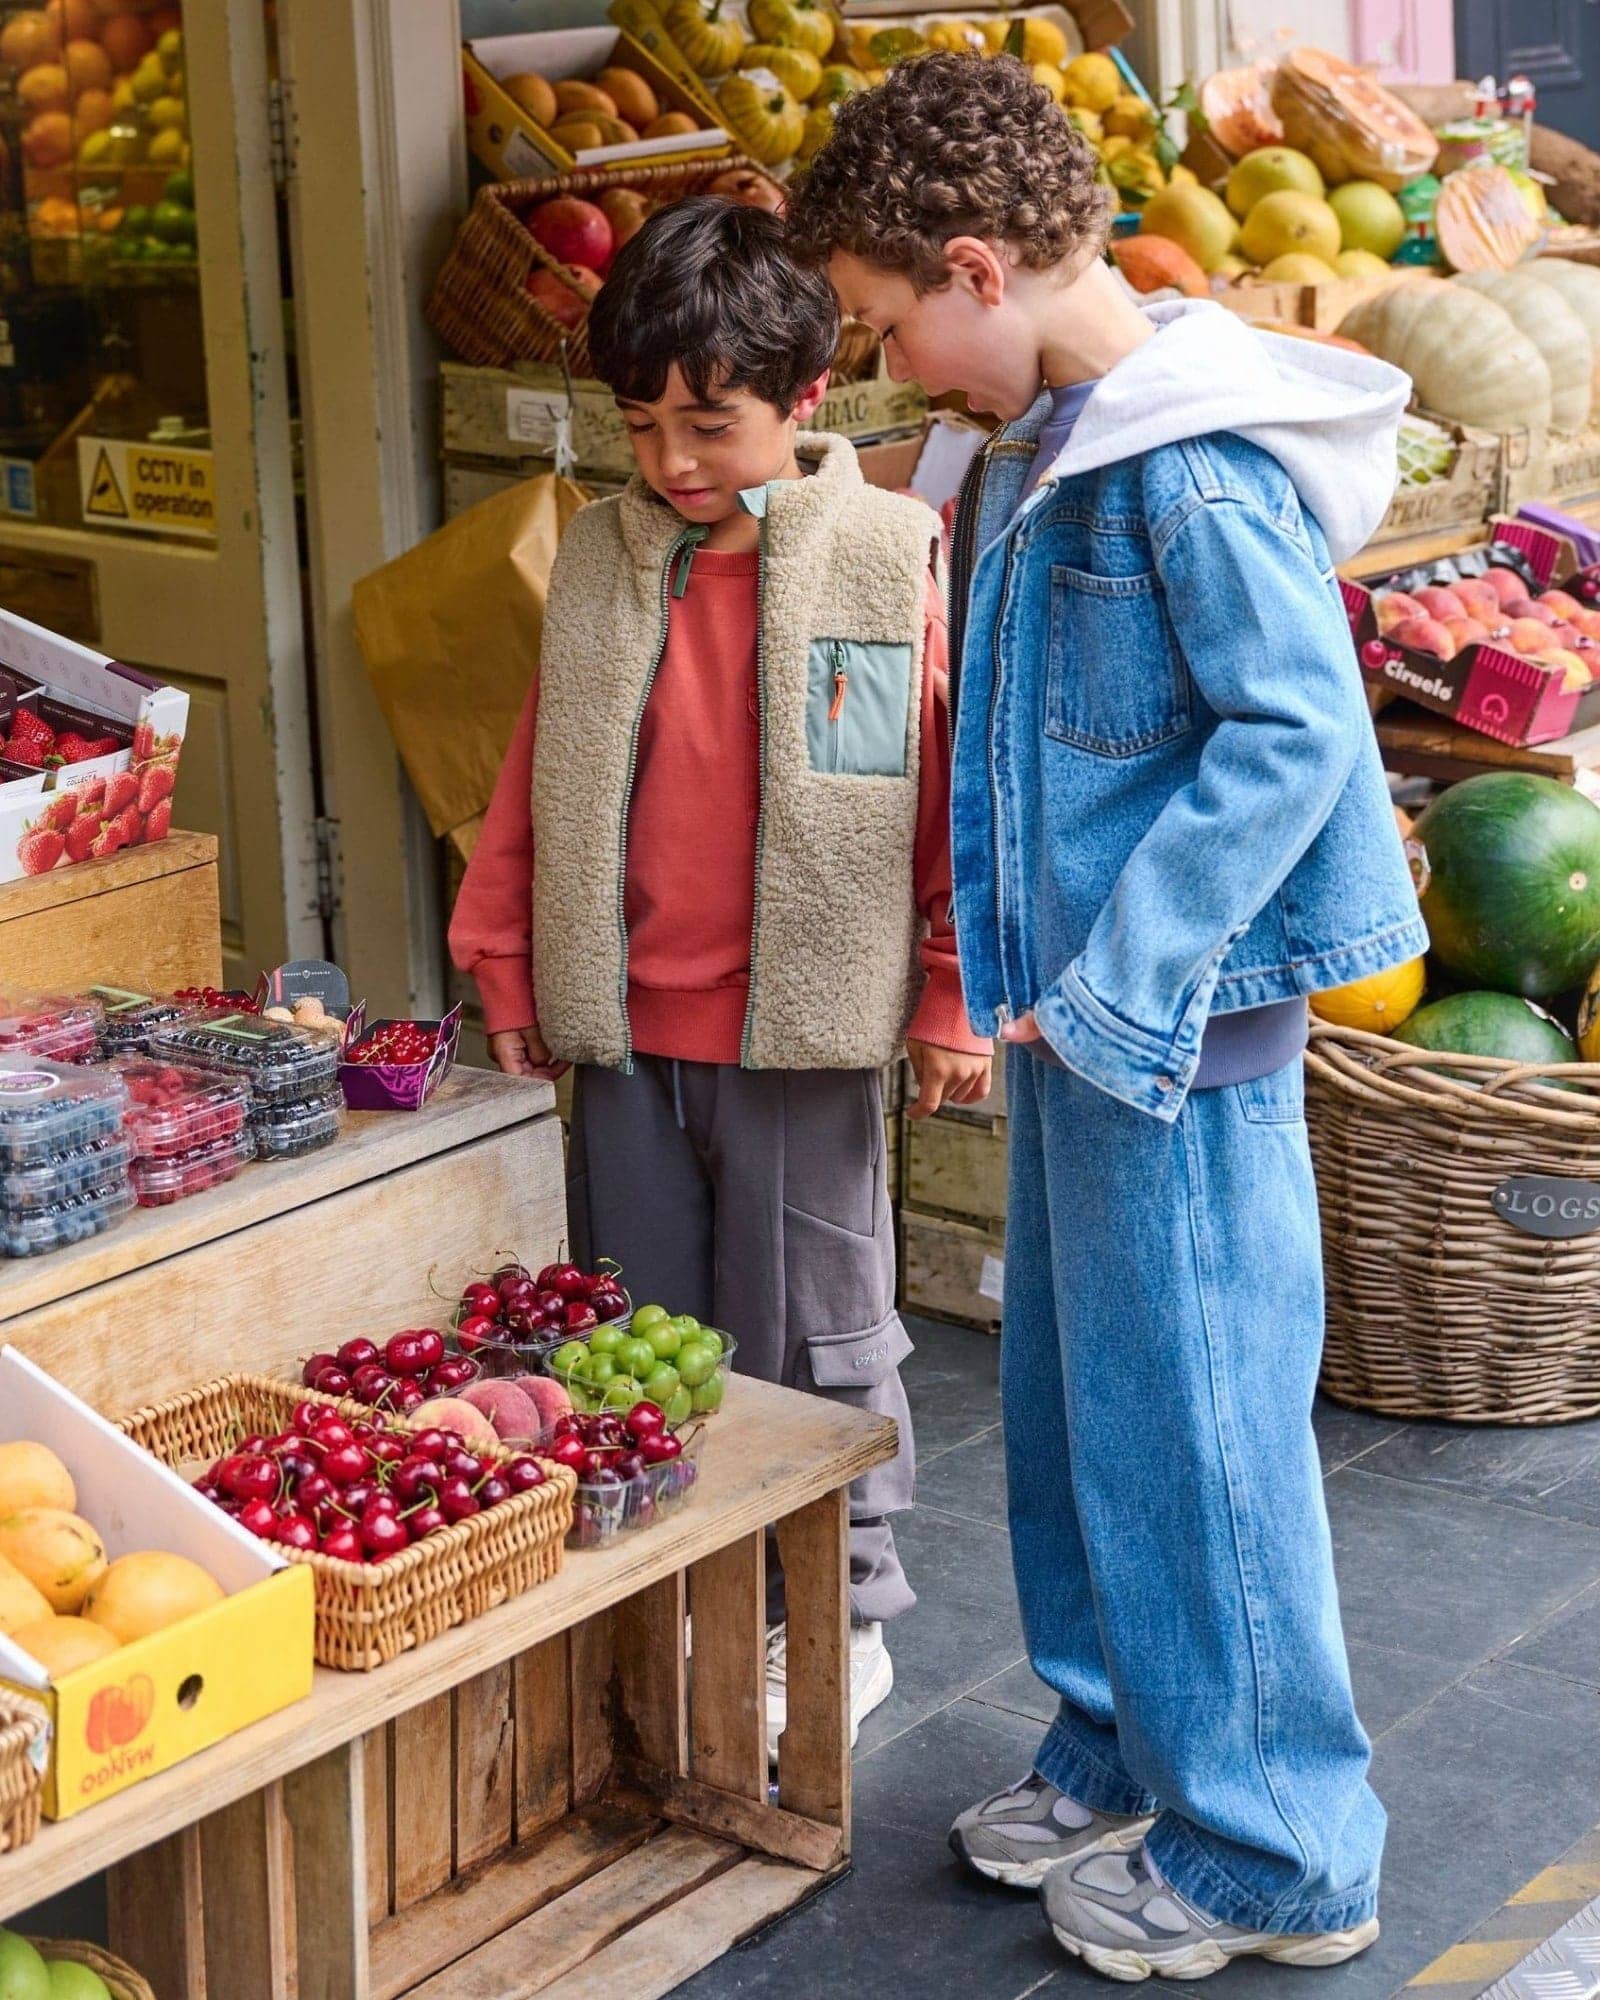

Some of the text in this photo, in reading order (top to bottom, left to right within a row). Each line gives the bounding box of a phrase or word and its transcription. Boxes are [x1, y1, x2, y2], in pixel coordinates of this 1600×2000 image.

[137, 457, 206, 488] CCTV in
[133, 491, 214, 519] operation
[1384, 658, 1454, 702] Ciruelo
[1507, 1189, 1600, 1220] LOGS
[80, 1743, 155, 1795] MANGO
